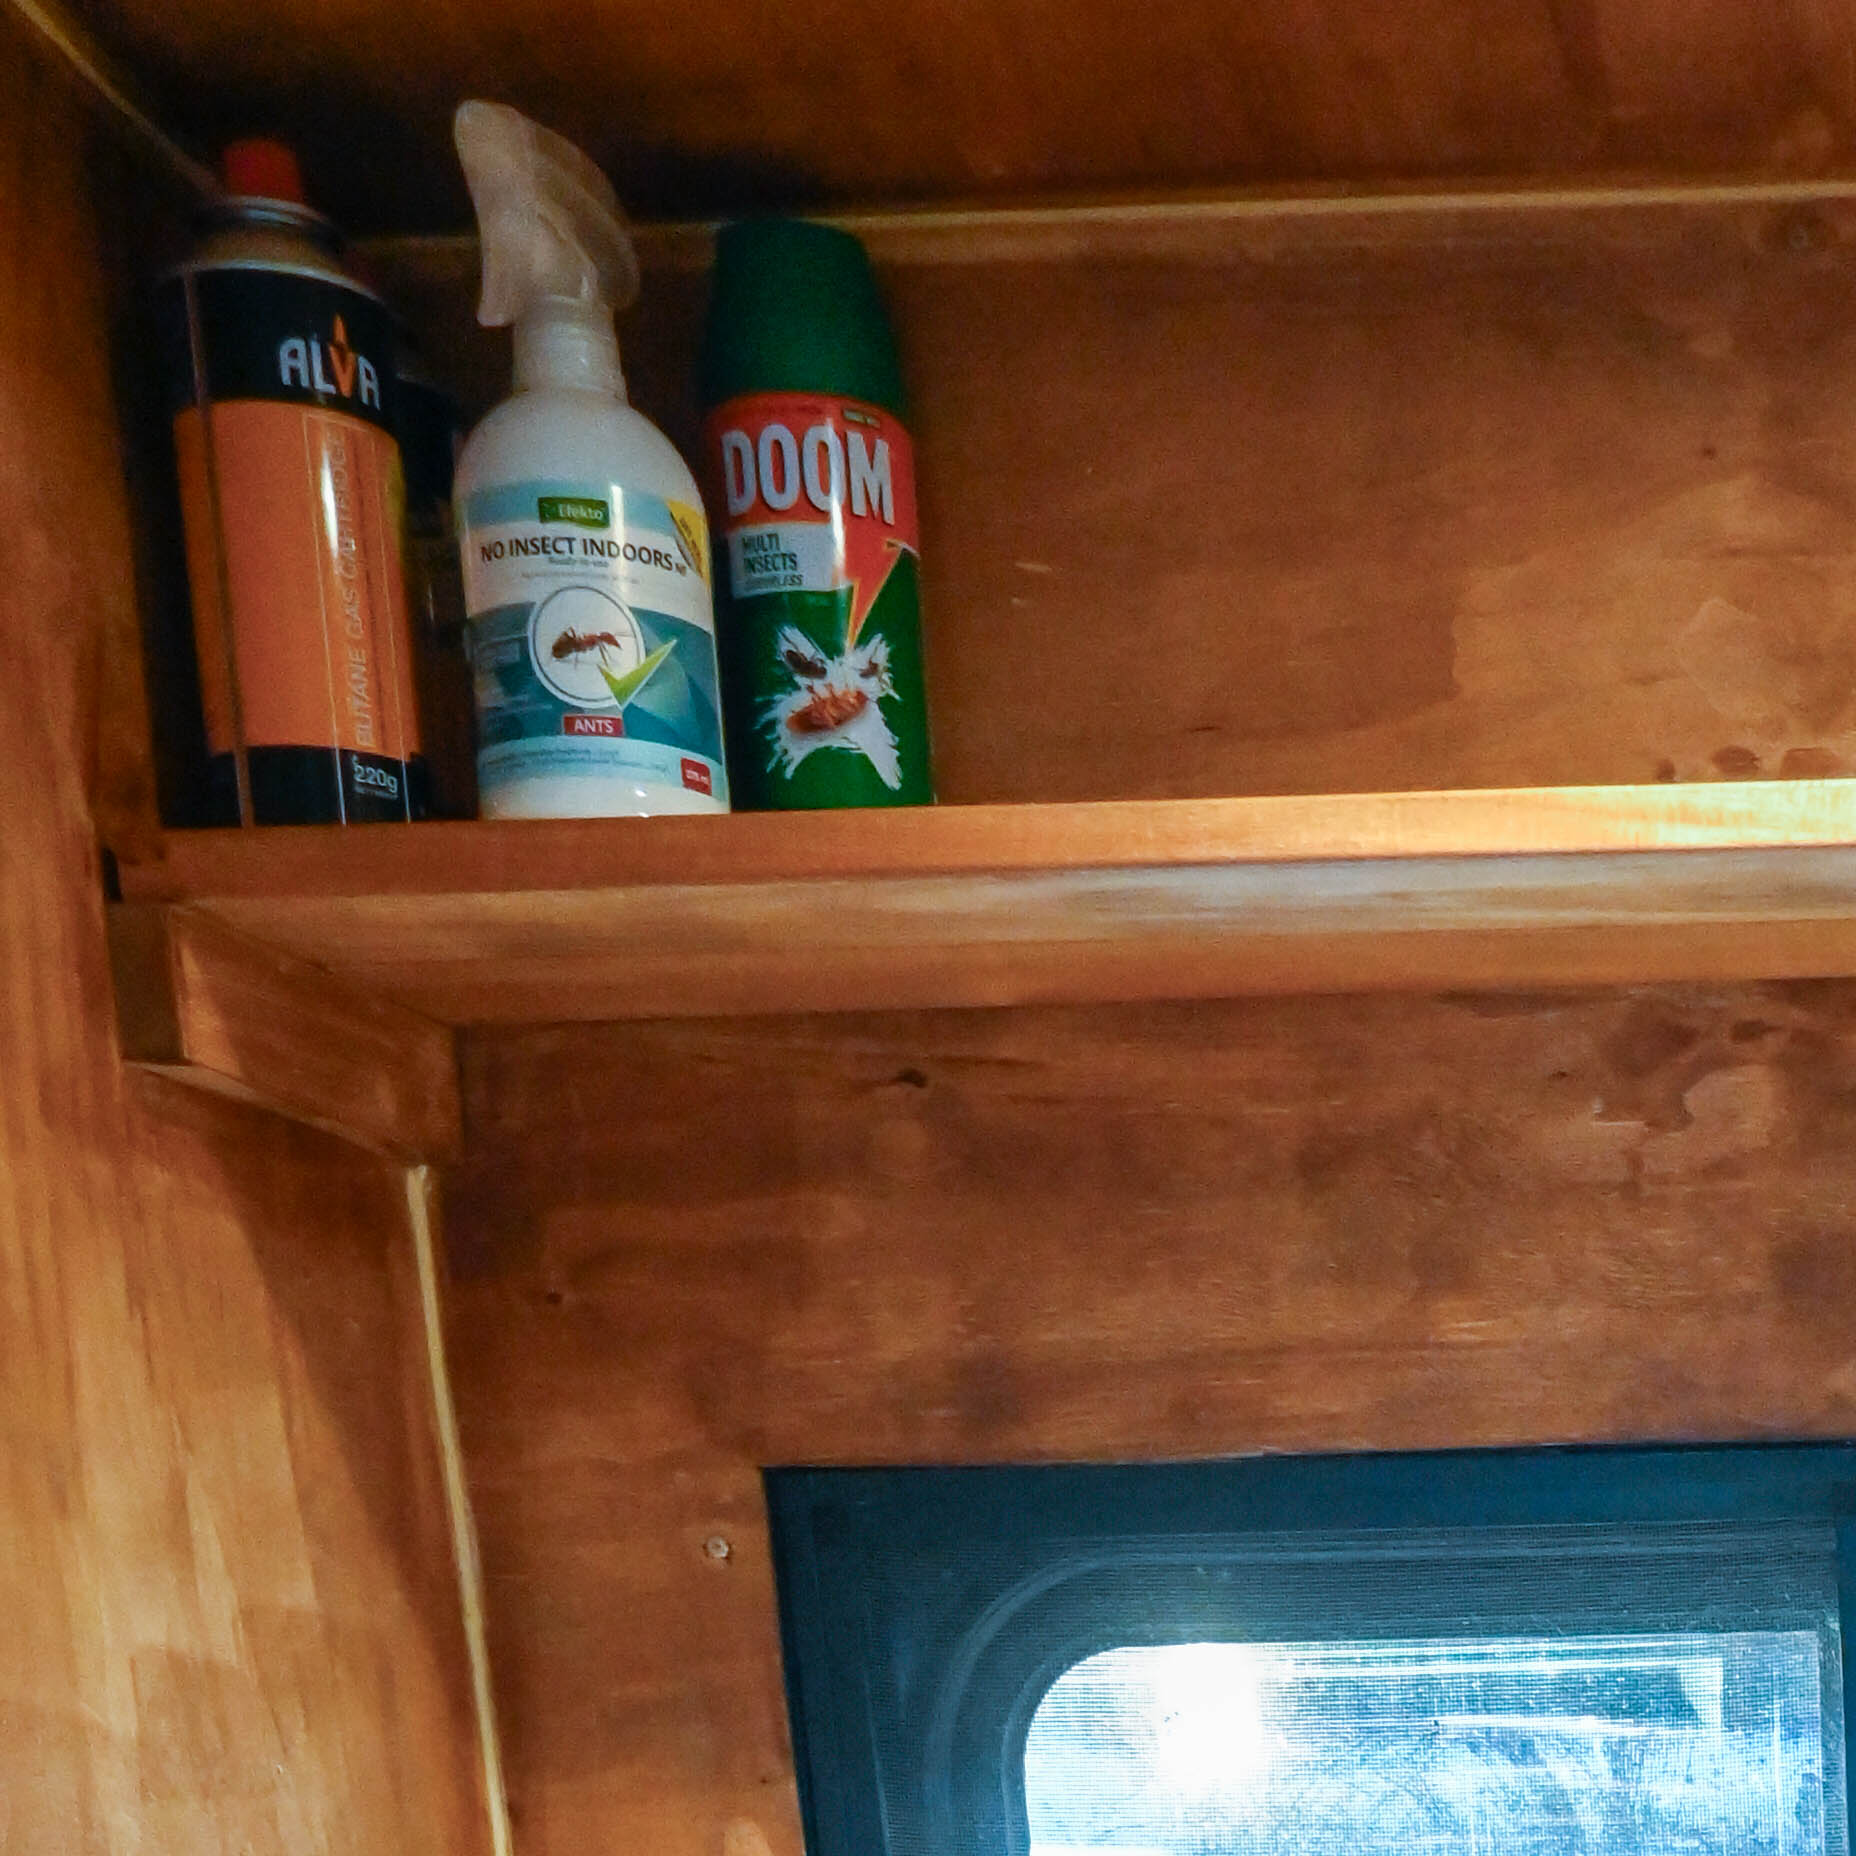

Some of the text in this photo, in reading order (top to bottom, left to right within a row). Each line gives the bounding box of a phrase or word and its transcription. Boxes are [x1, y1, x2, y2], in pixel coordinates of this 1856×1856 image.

[278, 330, 381, 411] ALVA
[720, 423, 896, 527] DOOM
[480, 541, 505, 563] NO
[509, 537, 577, 556] INSECT
[583, 538, 674, 571] INDOORS
[741, 533, 781, 554] MULTI
[743, 551, 798, 575] INSECTS
[574, 719, 614, 734] ANTS
[353, 765, 400, 795] 220g
